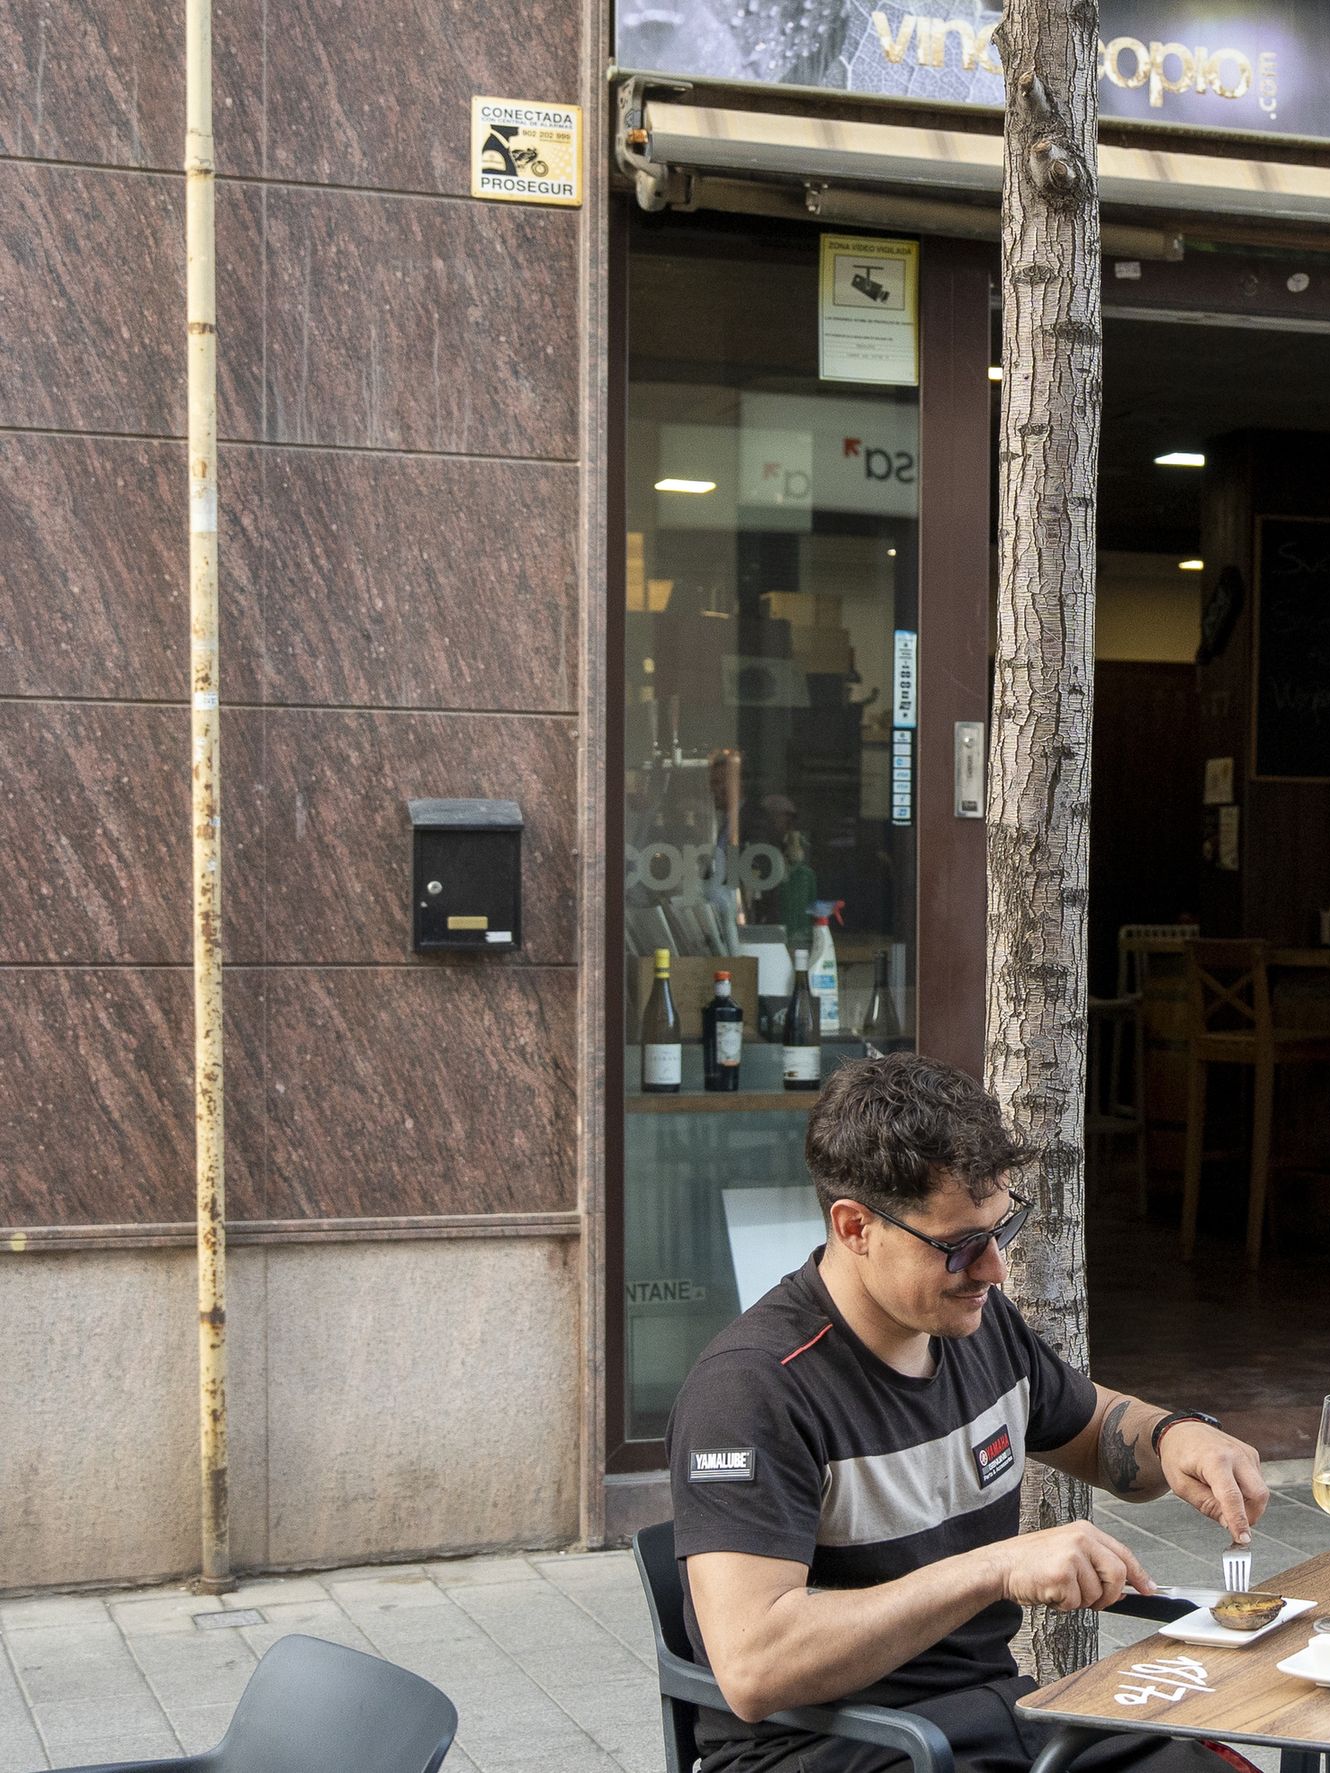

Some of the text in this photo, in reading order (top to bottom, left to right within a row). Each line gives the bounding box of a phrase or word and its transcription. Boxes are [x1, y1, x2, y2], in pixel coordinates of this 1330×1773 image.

[482, 106, 573, 124] CONECTADA
[481, 177, 573, 196] PROSEGUR
[828, 242, 850, 250] ZONA
[696, 1452, 747, 1470] YAMALUBE
